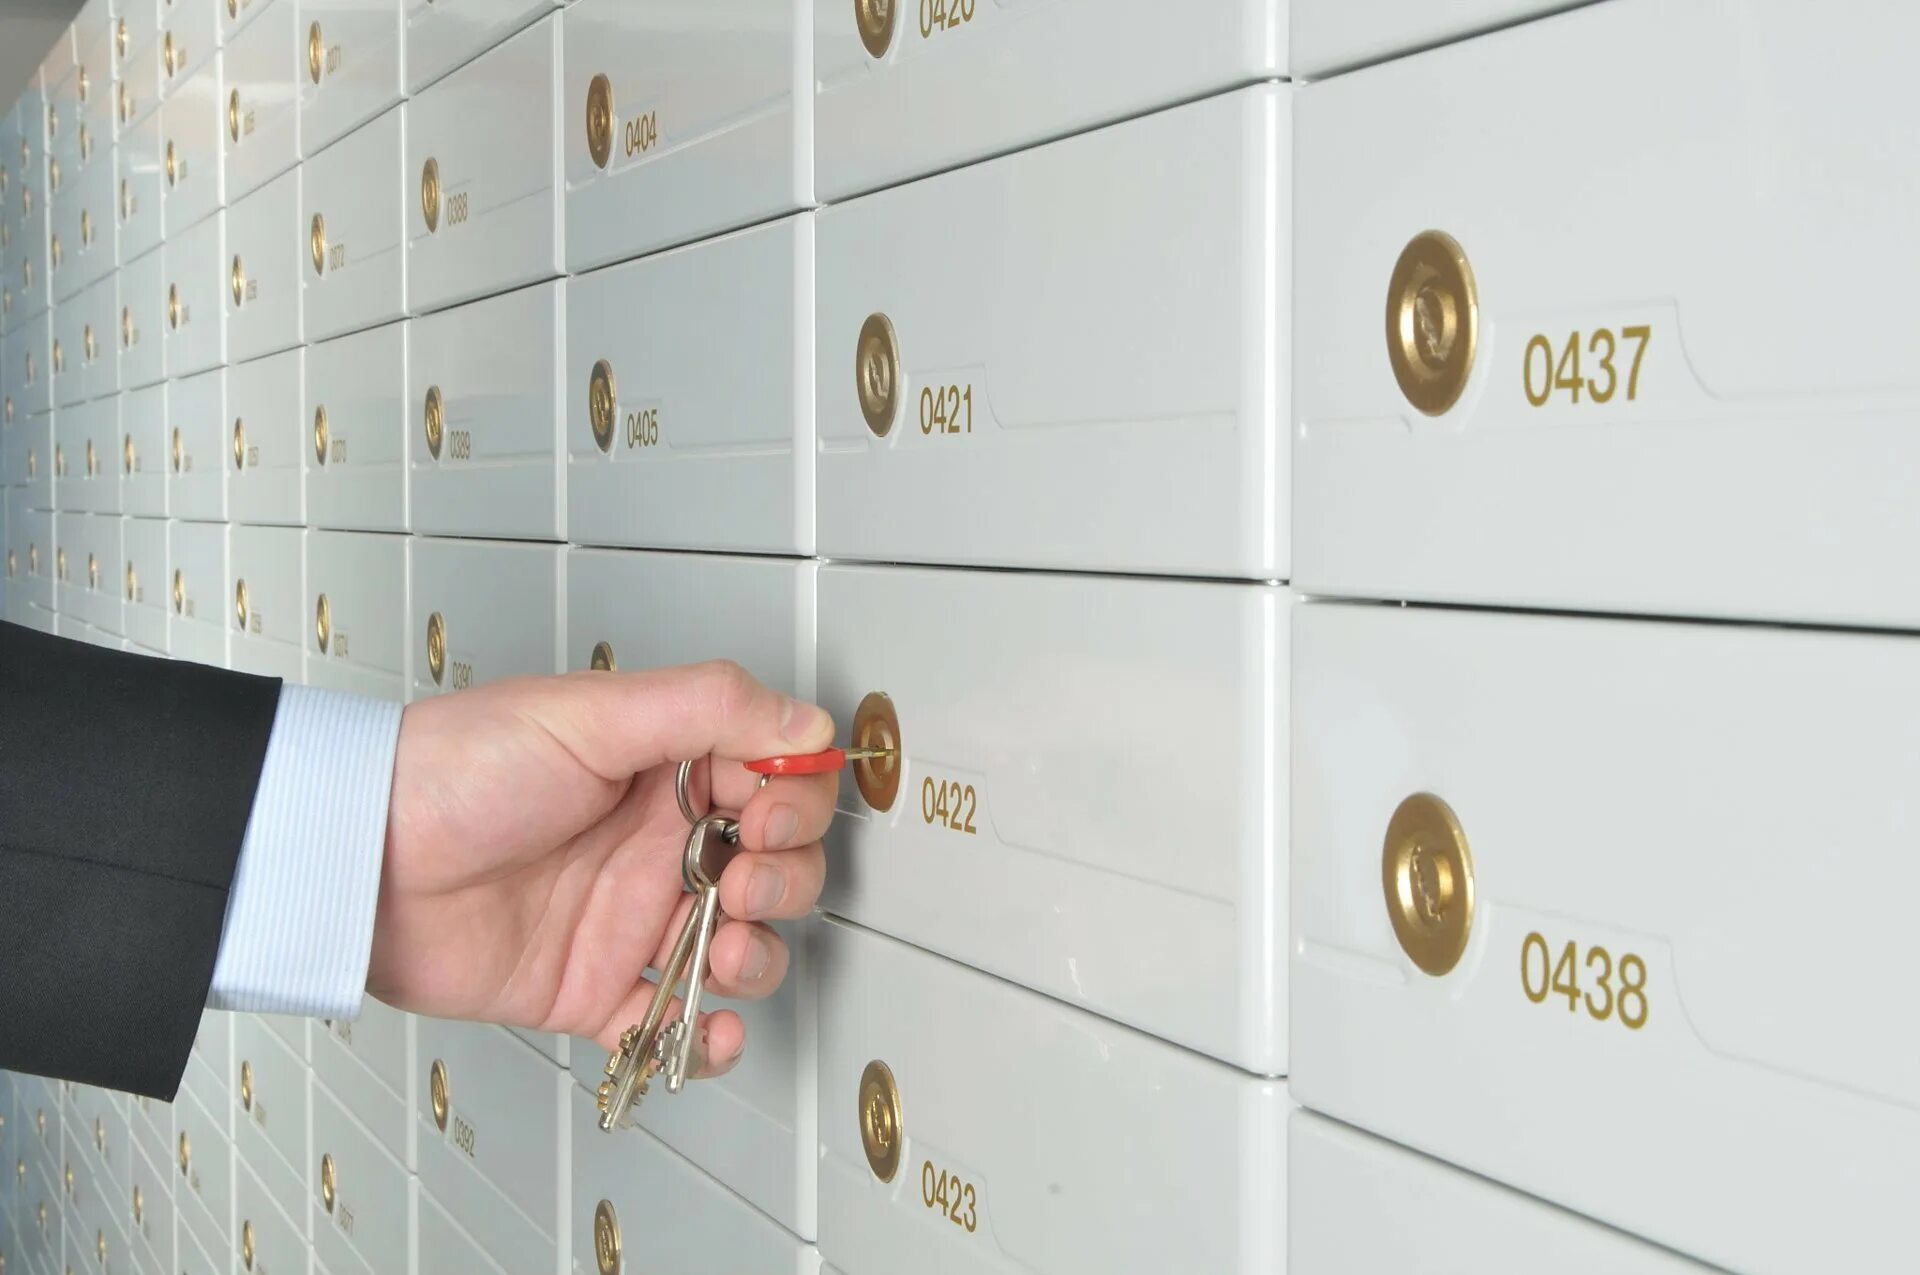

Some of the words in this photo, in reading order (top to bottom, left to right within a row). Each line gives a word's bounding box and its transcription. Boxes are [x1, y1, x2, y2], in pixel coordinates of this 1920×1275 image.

[626, 110, 657, 157] 0404
[447, 191, 468, 226] 0388
[1522, 325, 1652, 408] 0437
[627, 408, 658, 449] 0405
[920, 384, 972, 435] 0421
[450, 431, 470, 460] 0389
[922, 776, 977, 835] 0422
[1521, 931, 1650, 1030] 0438
[455, 1115, 474, 1157] 0392
[921, 1160, 977, 1232] 0423
